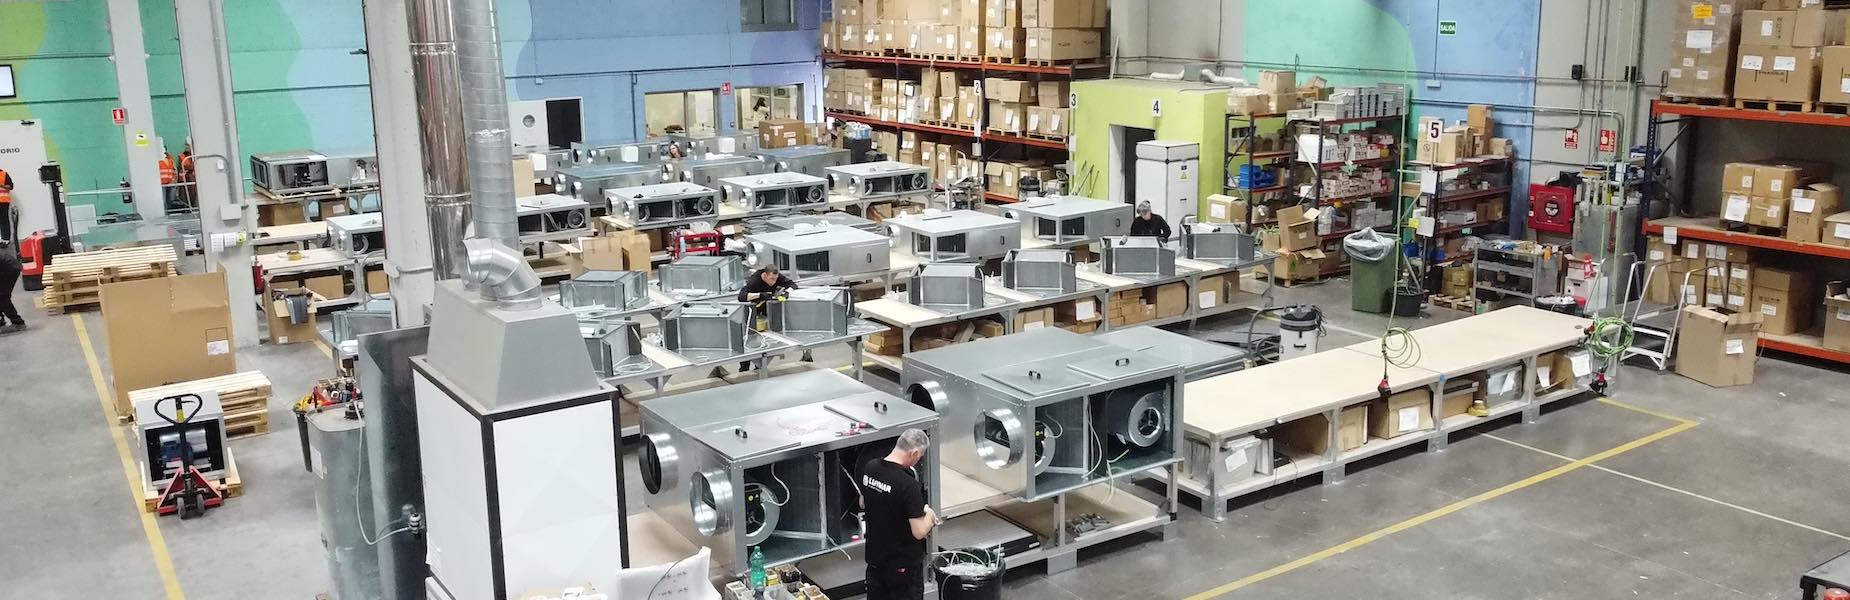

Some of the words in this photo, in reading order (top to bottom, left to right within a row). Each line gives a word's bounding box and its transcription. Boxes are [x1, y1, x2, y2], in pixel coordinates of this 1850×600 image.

[1440, 24, 1456, 32] SALIDA
[975, 82, 980, 94] 2
[1071, 93, 1077, 107] 3
[1153, 100, 1160, 114] 4
[1430, 121, 1440, 139] 5
